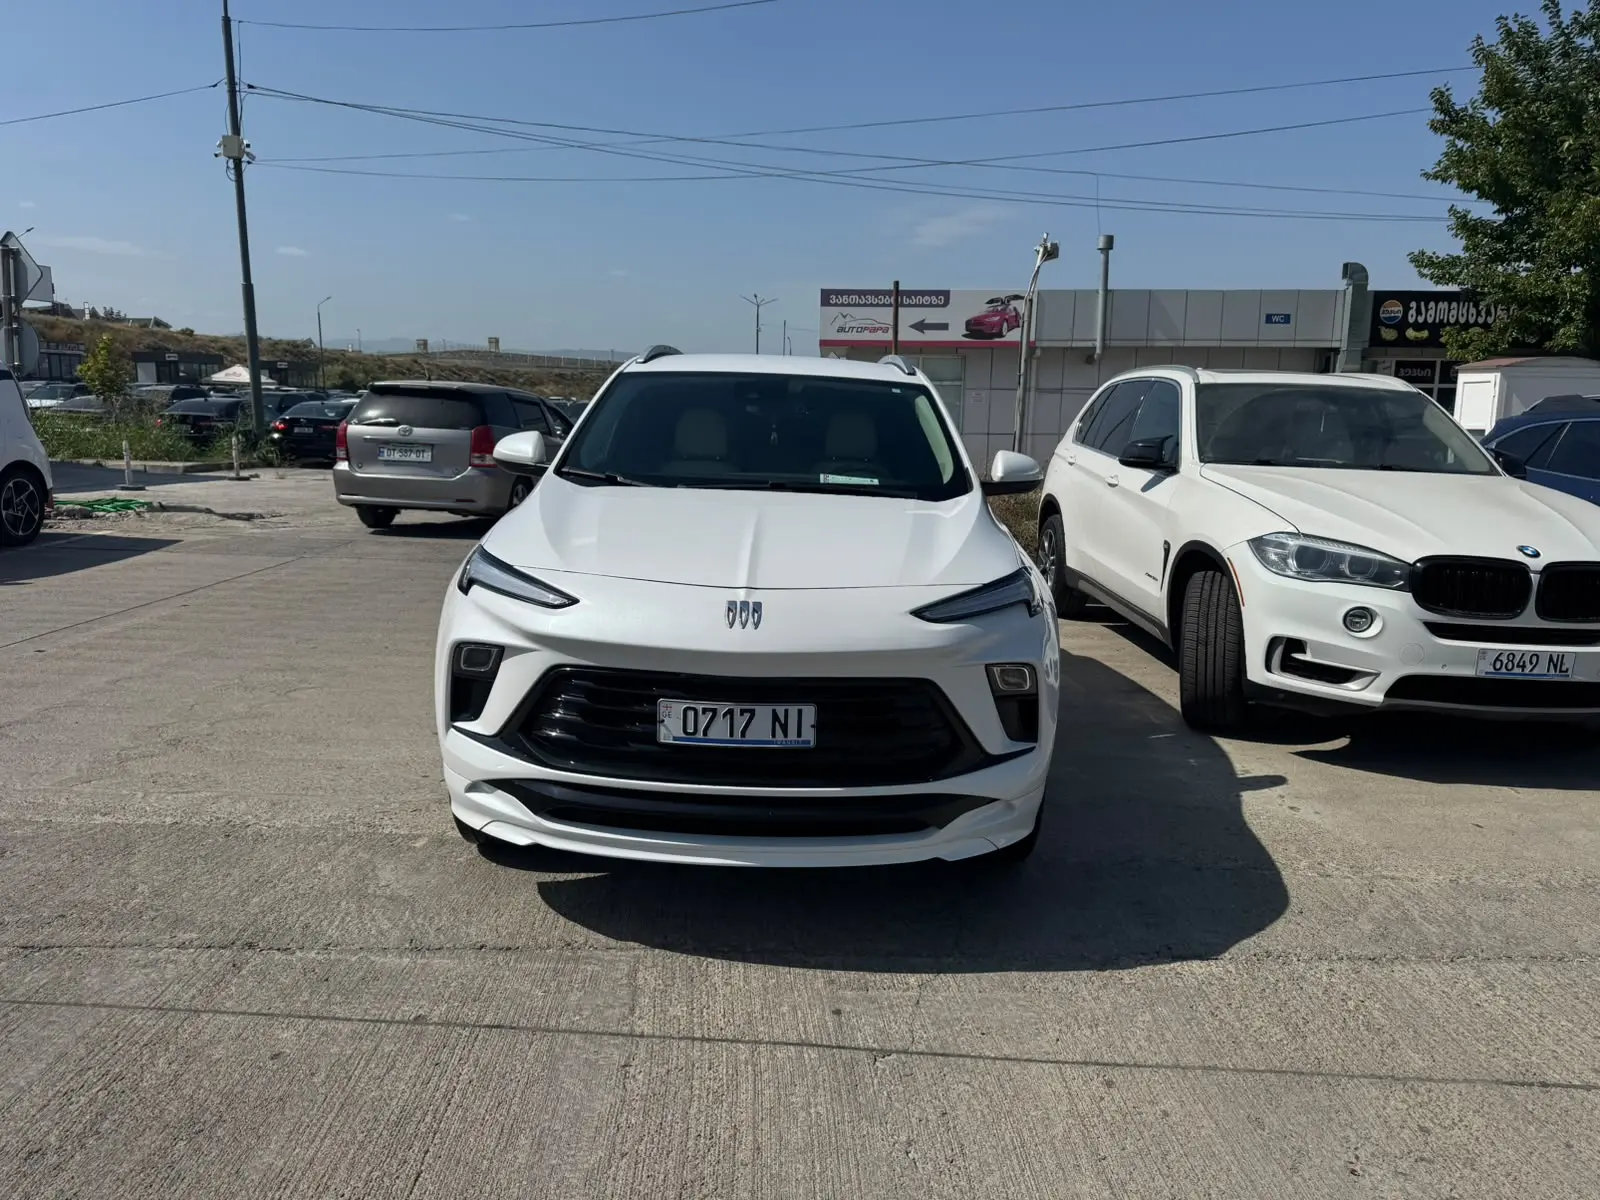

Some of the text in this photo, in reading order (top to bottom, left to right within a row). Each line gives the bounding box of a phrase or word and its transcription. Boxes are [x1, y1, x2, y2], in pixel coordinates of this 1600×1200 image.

[903, 295, 945, 305] საიტზე
[1271, 314, 1285, 323] WC
[1492, 652, 1569, 673] 6849 NL
[662, 710, 673, 719] GE
[681, 705, 803, 739] 0717 NI
